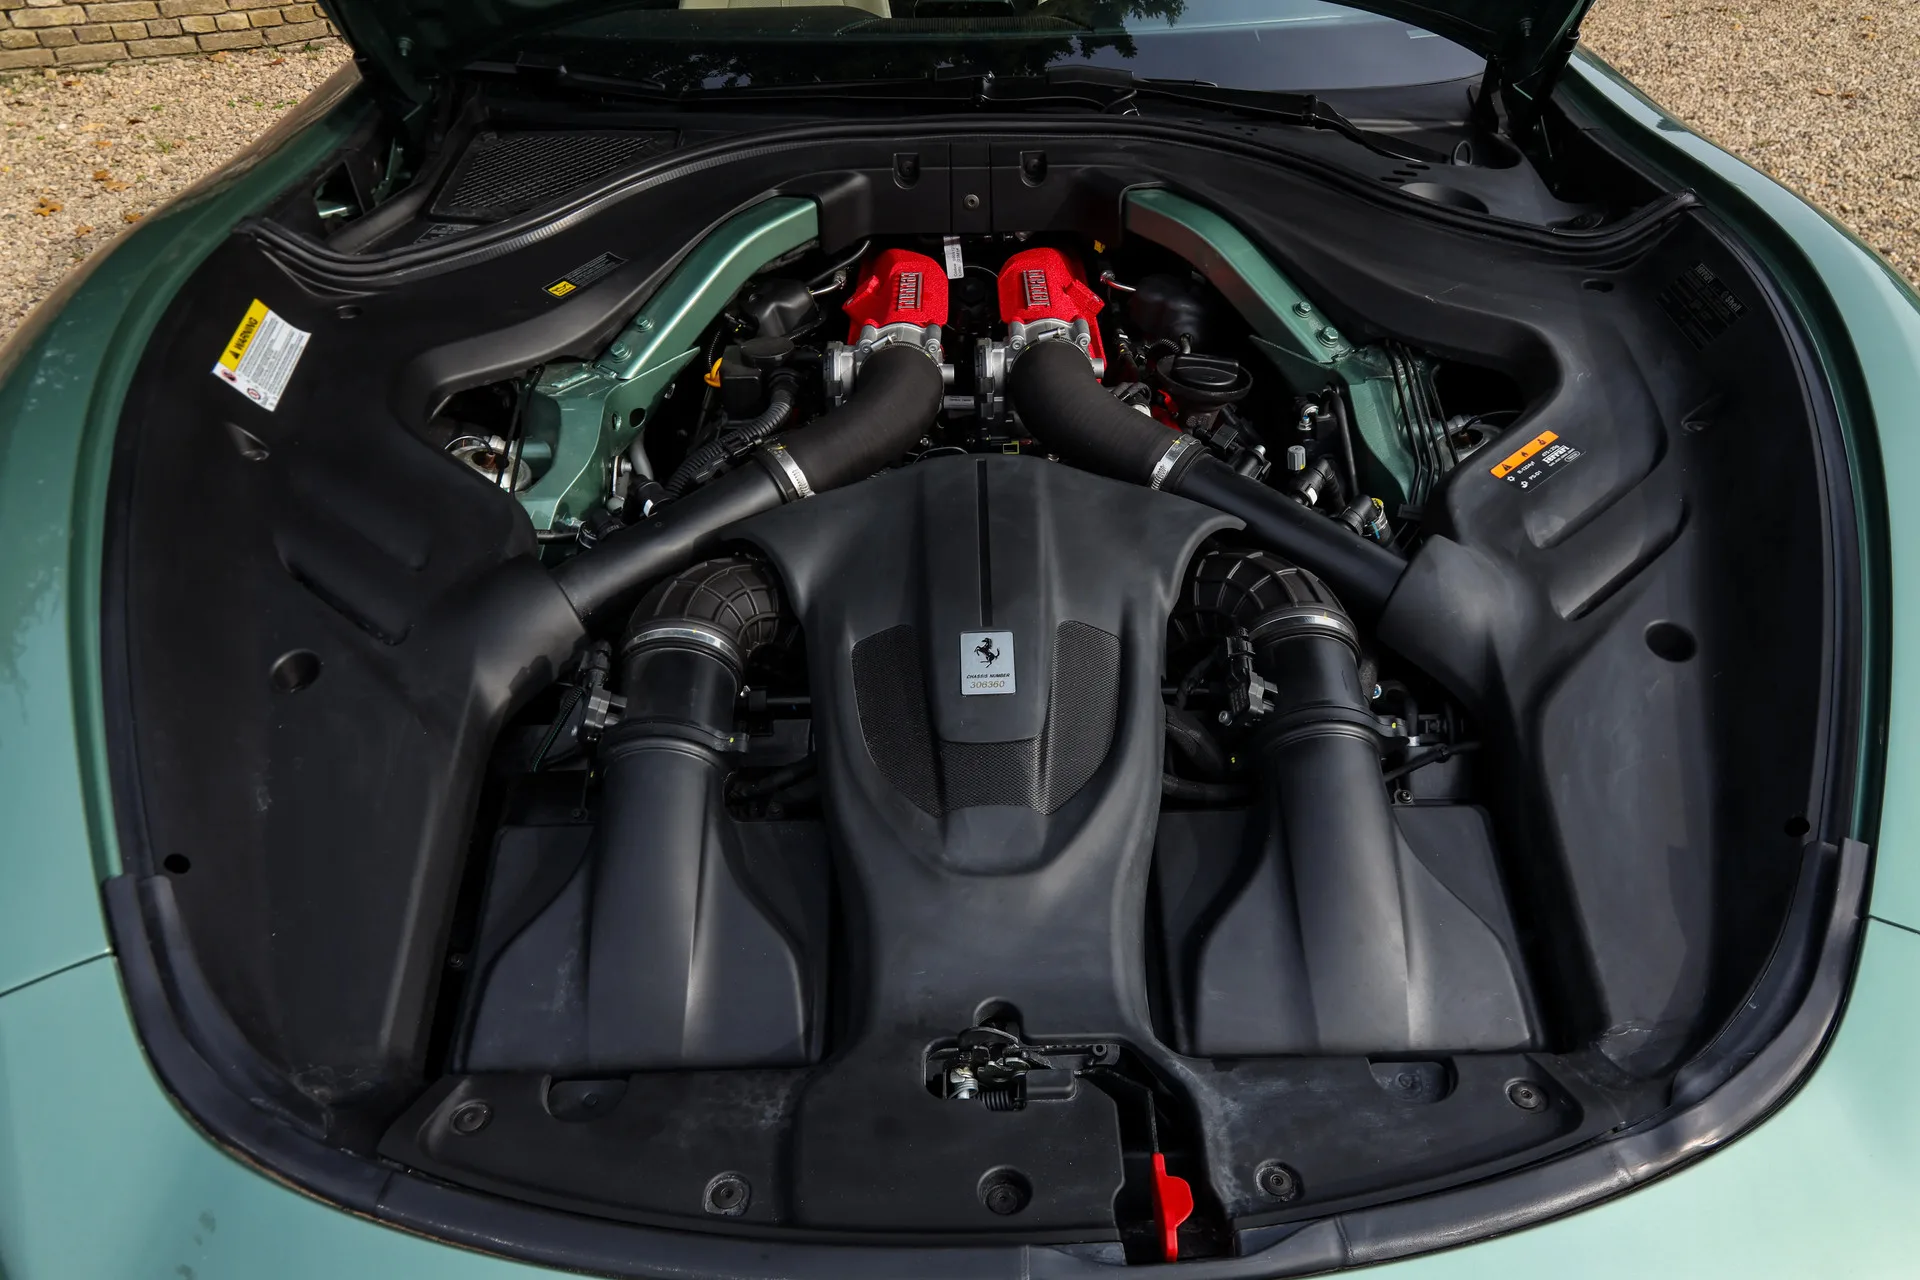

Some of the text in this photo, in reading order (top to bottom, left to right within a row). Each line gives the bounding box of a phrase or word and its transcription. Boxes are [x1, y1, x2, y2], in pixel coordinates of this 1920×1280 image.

[898, 272, 923, 309] Ferrari
[1023, 269, 1050, 306] Ferrari
[1725, 295, 1743, 313] Shell
[234, 317, 258, 350] WARNING
[1542, 444, 1570, 464] Ferrari
